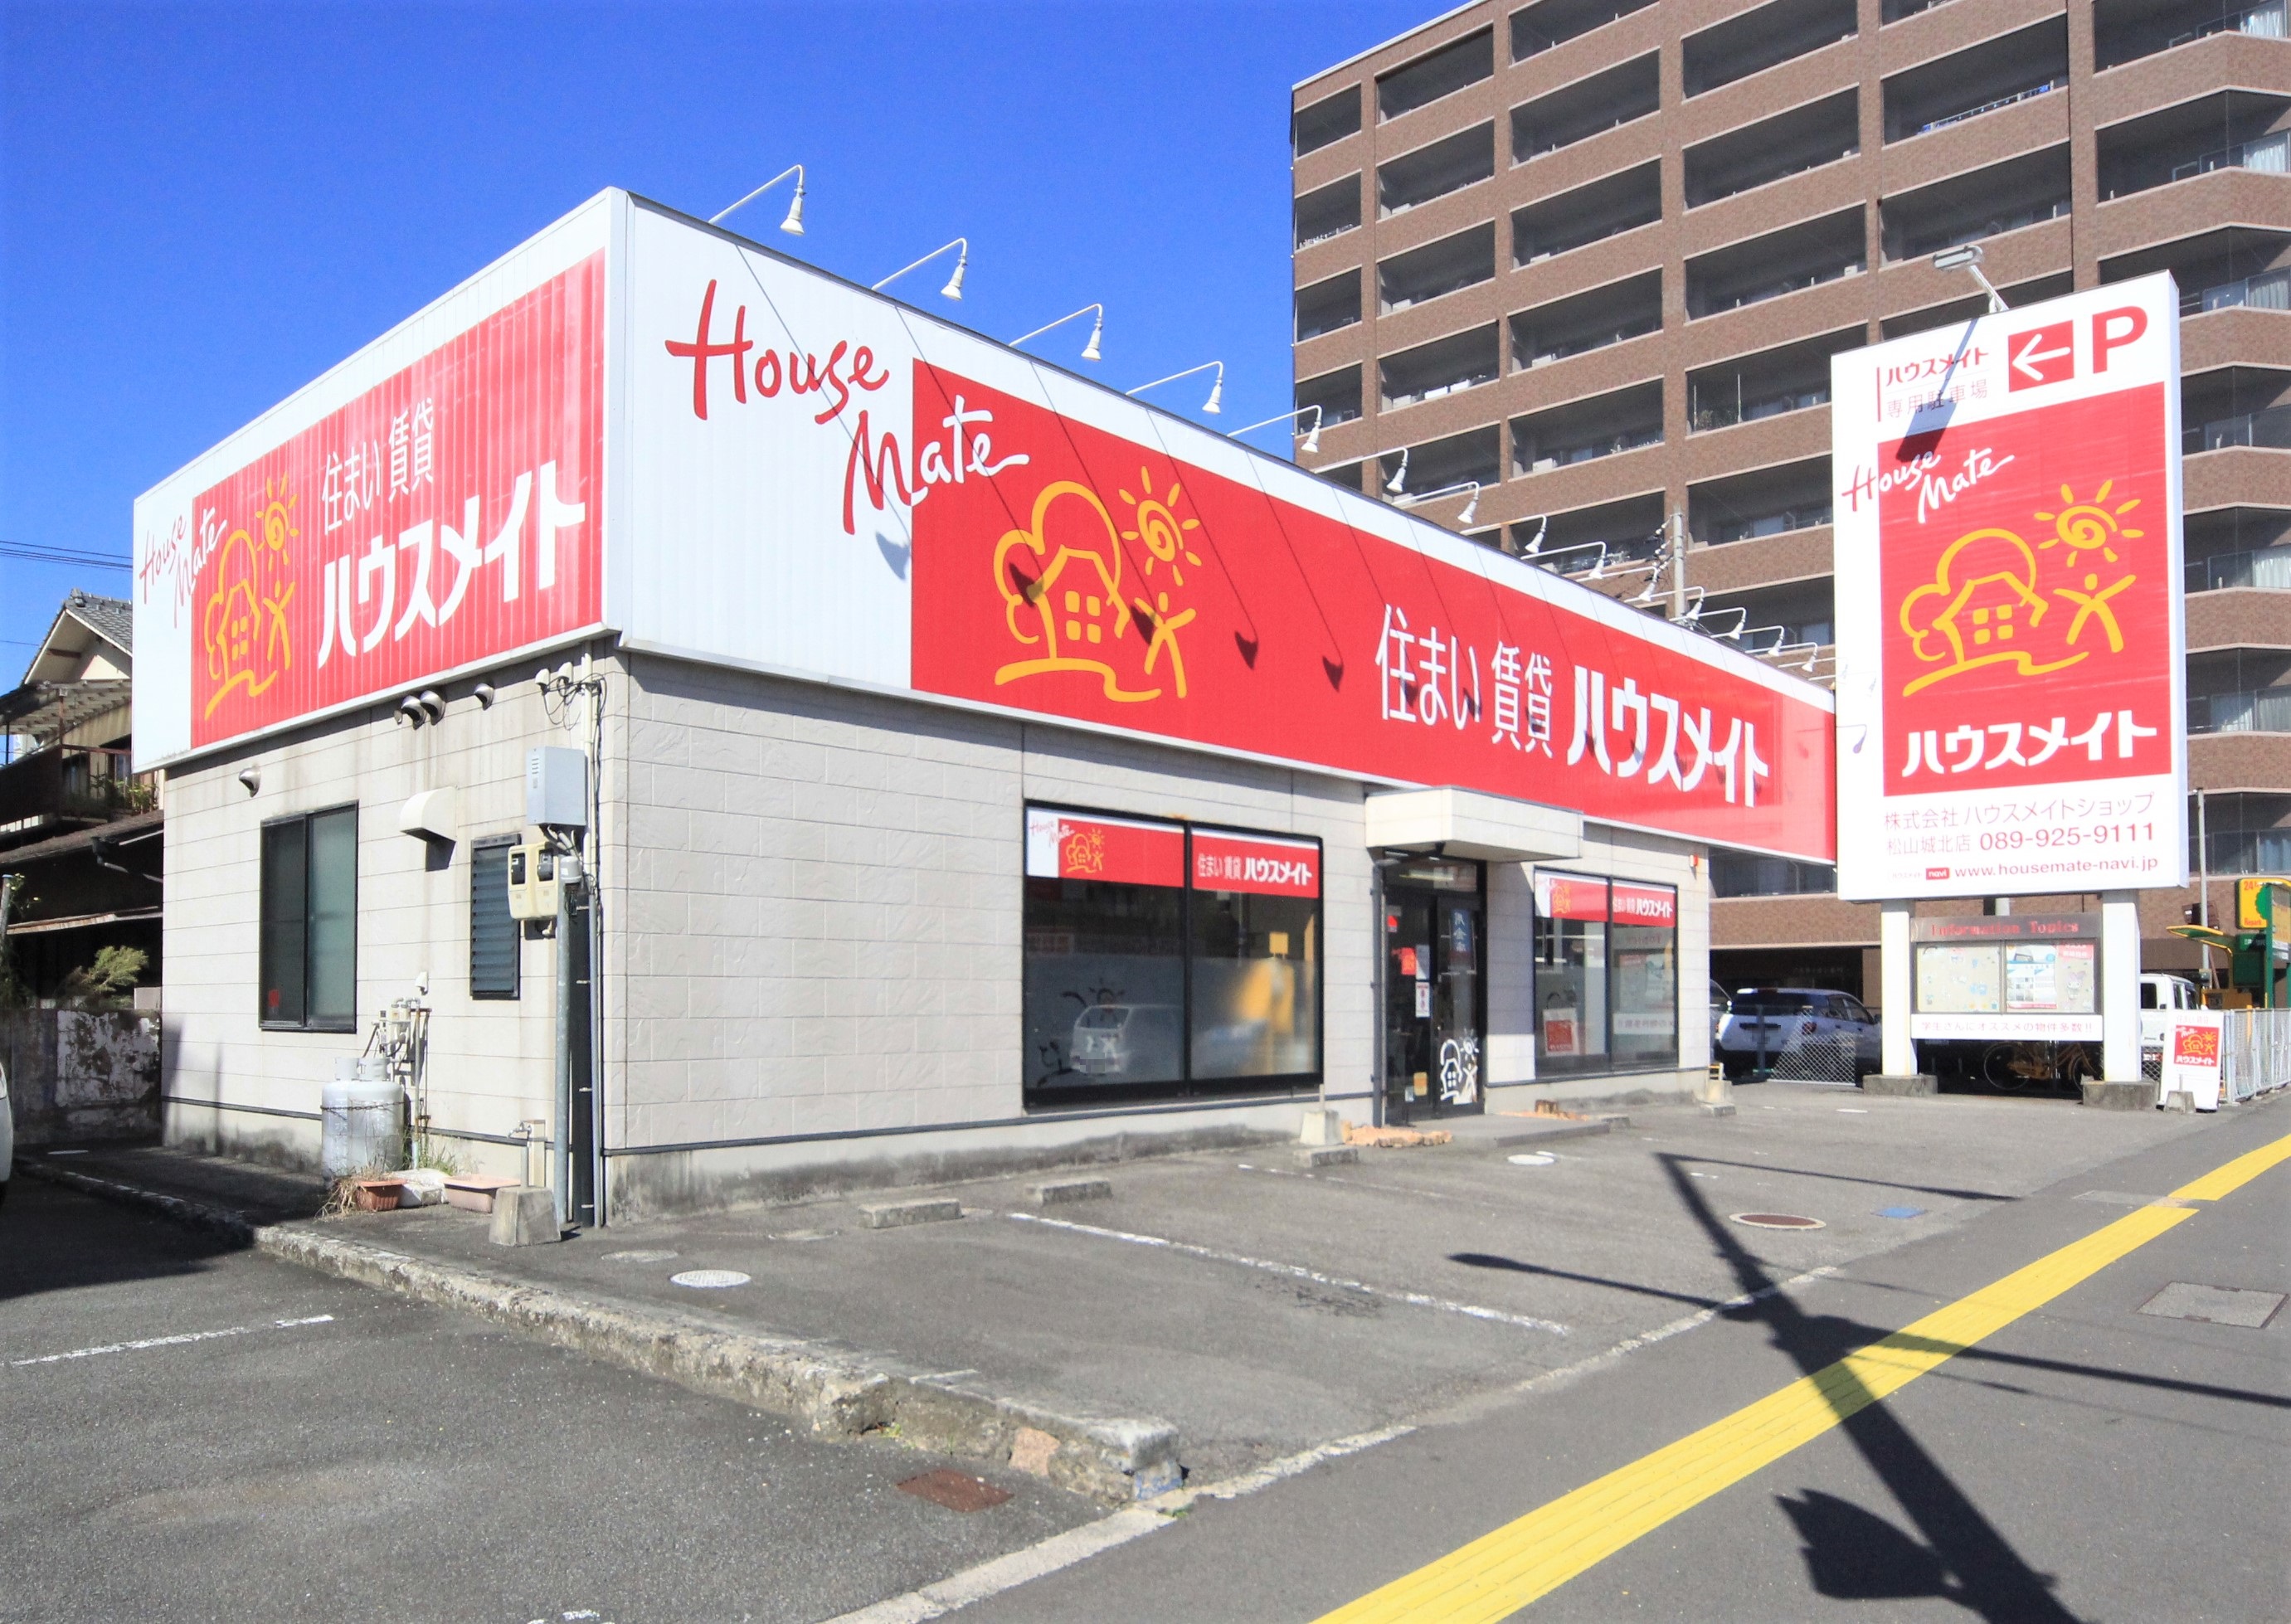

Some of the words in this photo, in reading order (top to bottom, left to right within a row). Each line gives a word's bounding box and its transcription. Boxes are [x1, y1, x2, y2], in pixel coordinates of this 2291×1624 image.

[665, 279, 888, 424] House
[1886, 347, 1989, 387] ハウスメイト
[2092, 306, 2148, 374] P
[1887, 379, 1987, 418] 専用駐車場
[843, 395, 1029, 535] Mate
[1841, 451, 1941, 512] House
[1918, 448, 2015, 523] Mate
[139, 514, 186, 604] House
[174, 507, 227, 628] Mate
[318, 459, 585, 669] ハウスメイト
[1568, 665, 1768, 808] ハウスメイト
[1901, 710, 2157, 777] ハウスメイト
[1243, 857, 1312, 886] ハウスメイト
[1886, 834, 1971, 856] 松山城北店
[1980, 823, 2153, 851] 089-925-9111
[1955, 856, 2158, 878] www.housemate-navi.jp
[1932, 922, 2021, 936] Information
[2029, 921, 2079, 935] Topics
[2176, 1055, 2215, 1065] ハウスメイト
